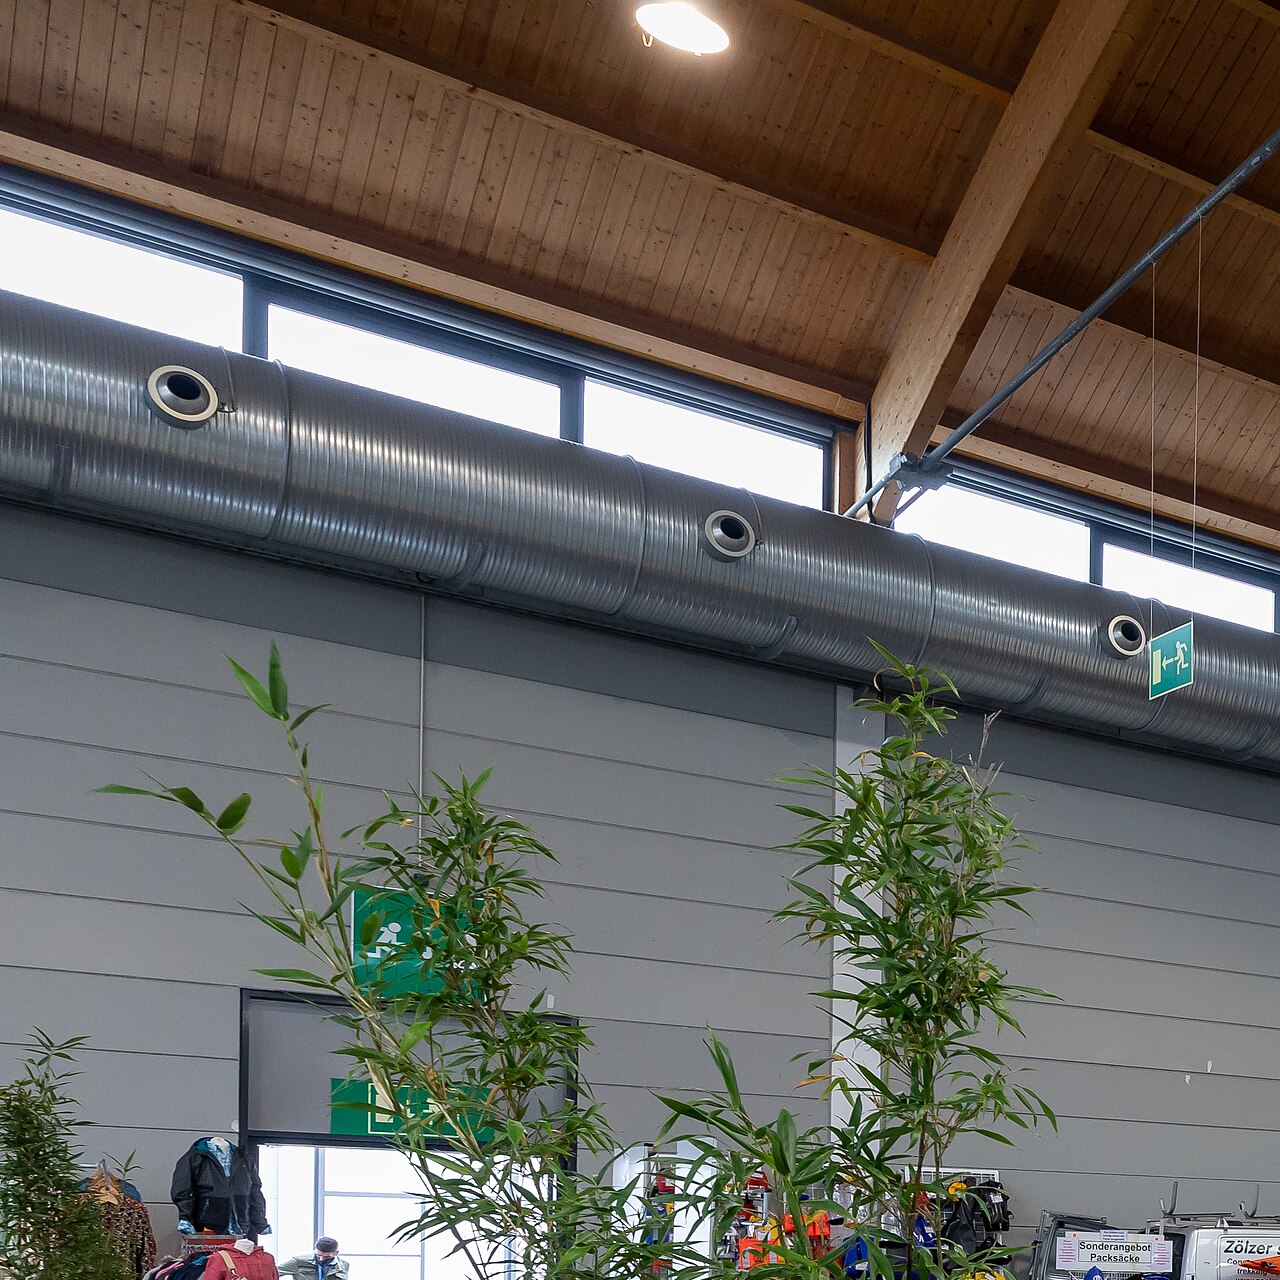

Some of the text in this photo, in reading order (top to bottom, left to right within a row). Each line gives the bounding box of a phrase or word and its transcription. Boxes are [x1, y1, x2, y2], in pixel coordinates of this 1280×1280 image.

[1079, 1241, 1152, 1253] Sonderangebot
[1224, 1240, 1273, 1254] Zölzer
[1090, 1253, 1141, 1263] Packsäcke
